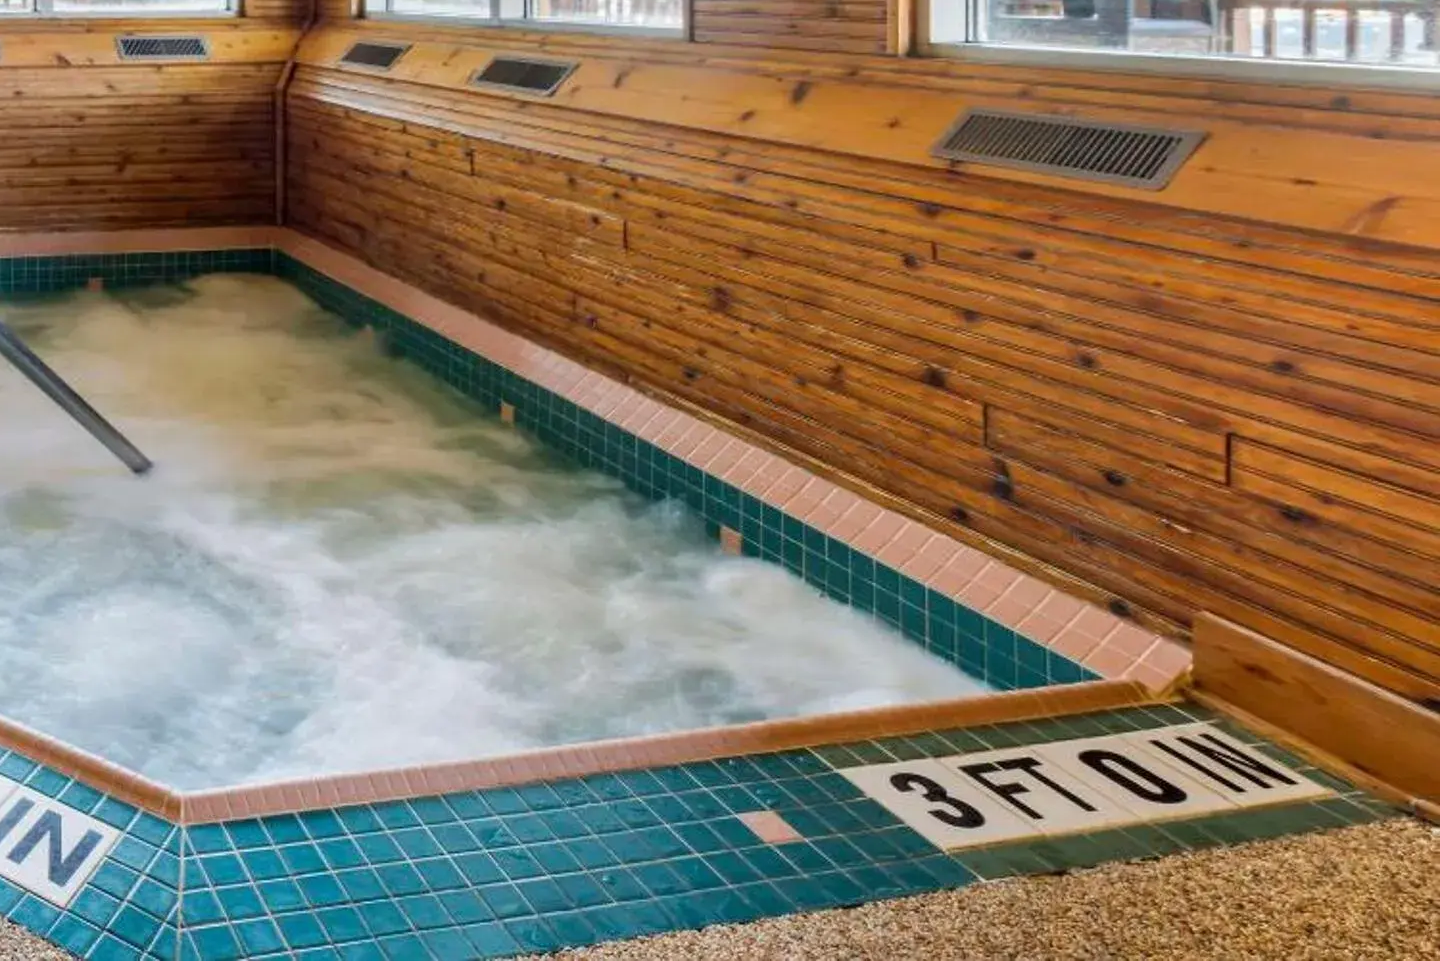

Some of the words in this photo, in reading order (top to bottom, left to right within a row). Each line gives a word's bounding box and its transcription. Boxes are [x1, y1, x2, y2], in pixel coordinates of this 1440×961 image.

[889, 771, 986, 829] 3
[958, 756, 1098, 820] FT
[1150, 733, 1299, 793] IN
